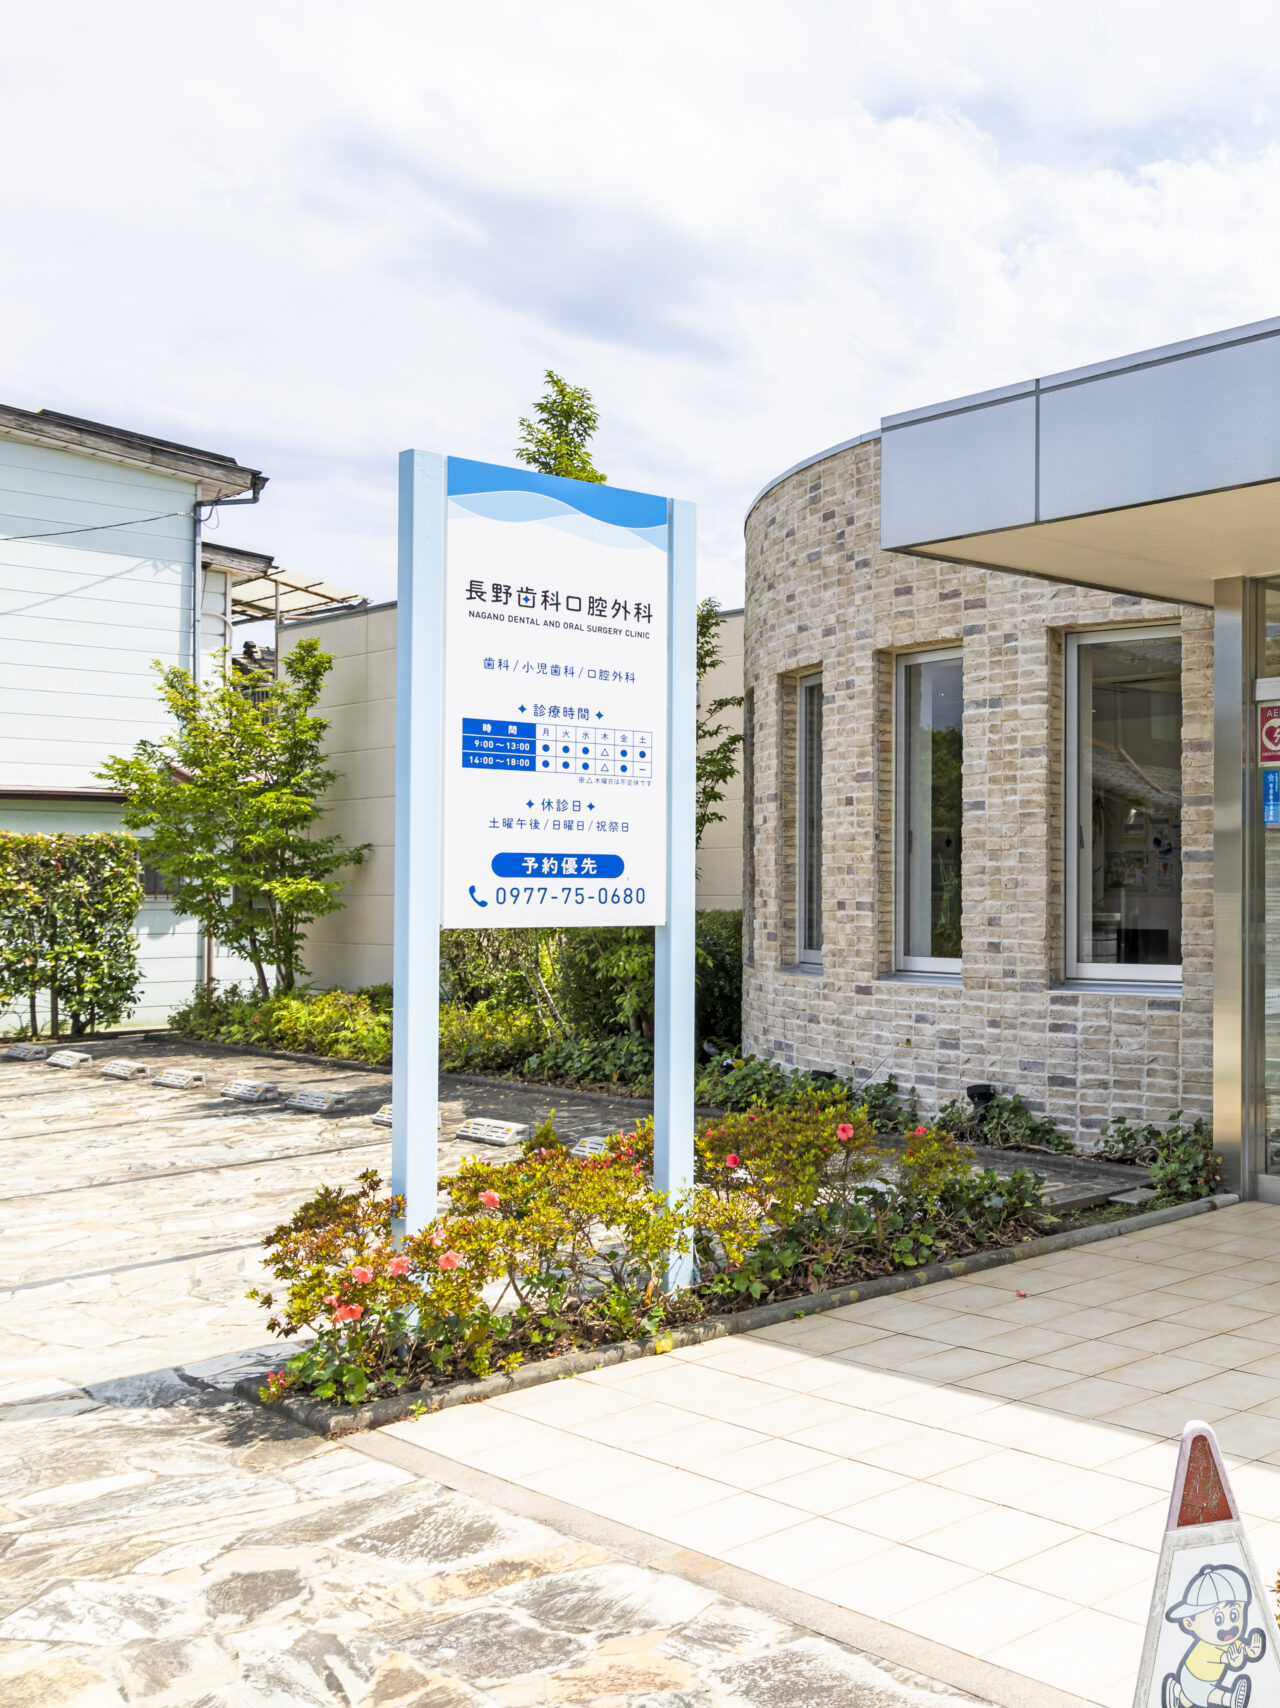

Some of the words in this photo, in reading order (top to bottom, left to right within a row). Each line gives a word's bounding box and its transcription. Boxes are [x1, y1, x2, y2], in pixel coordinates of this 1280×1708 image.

[465, 579, 653, 624] 長野歯科口腔外科
[468, 610, 505, 622] NAGANO
[508, 614, 541, 627] DENTAL
[543, 619, 561, 629] AND
[563, 621, 585, 632] ORAL
[586, 624, 623, 636] SURGERY
[624, 629, 651, 640] CLINIC
[533, 703, 590, 721] 診療時間
[542, 727, 550, 737] 月
[562, 729, 570, 739] 火
[582, 731, 590, 740] 水
[601, 732, 609, 740] 木
[620, 734, 628, 743] 金
[639, 735, 647, 744] 土
[541, 798, 582, 812] 休診日
[521, 856, 598, 875] 予約優先
[496, 887, 645, 905] 0977-75-0680
